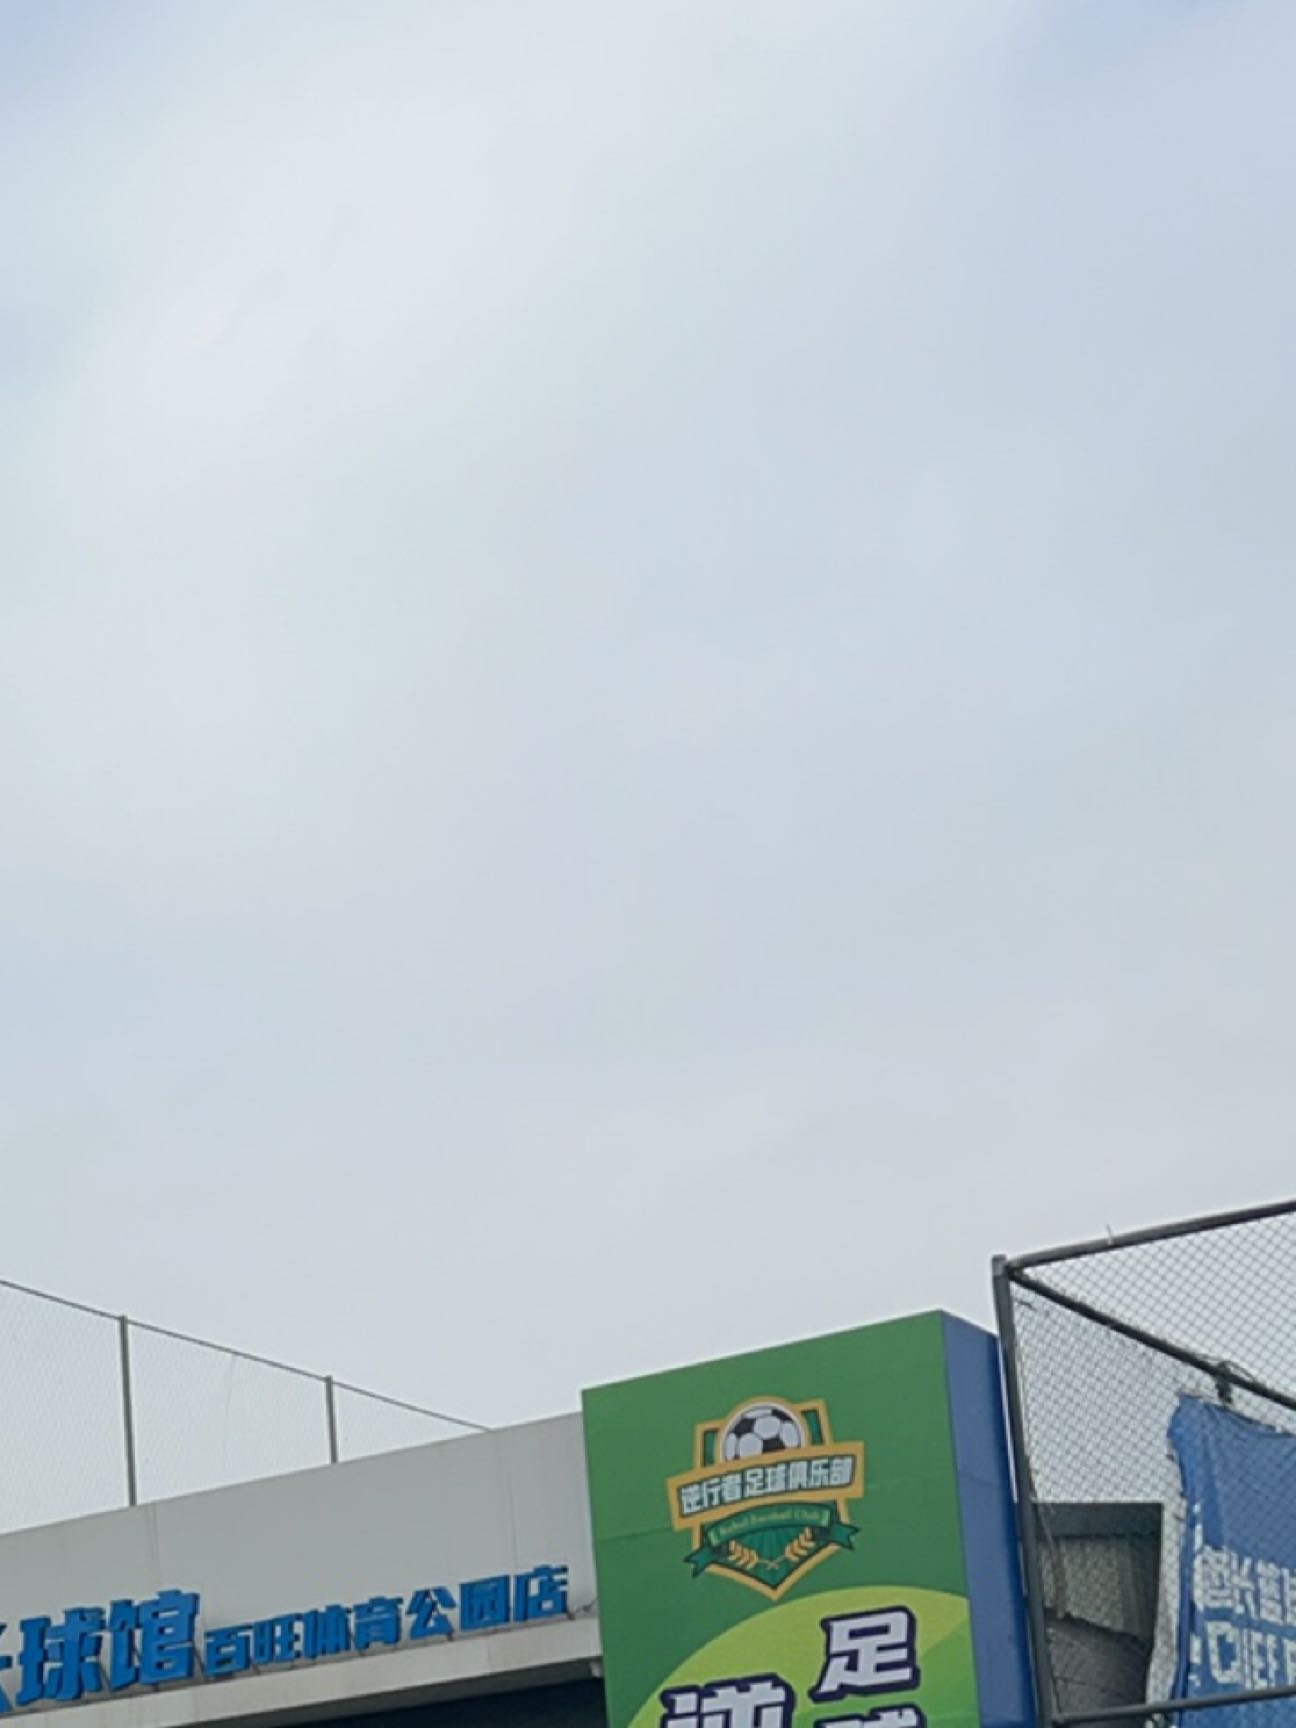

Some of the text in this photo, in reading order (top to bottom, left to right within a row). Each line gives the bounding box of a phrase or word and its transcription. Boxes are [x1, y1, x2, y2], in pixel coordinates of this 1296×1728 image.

[680, 1455, 855, 1516] 逆行者足球俱乐部
[204, 1564, 569, 1678] 百旺体育公园店
